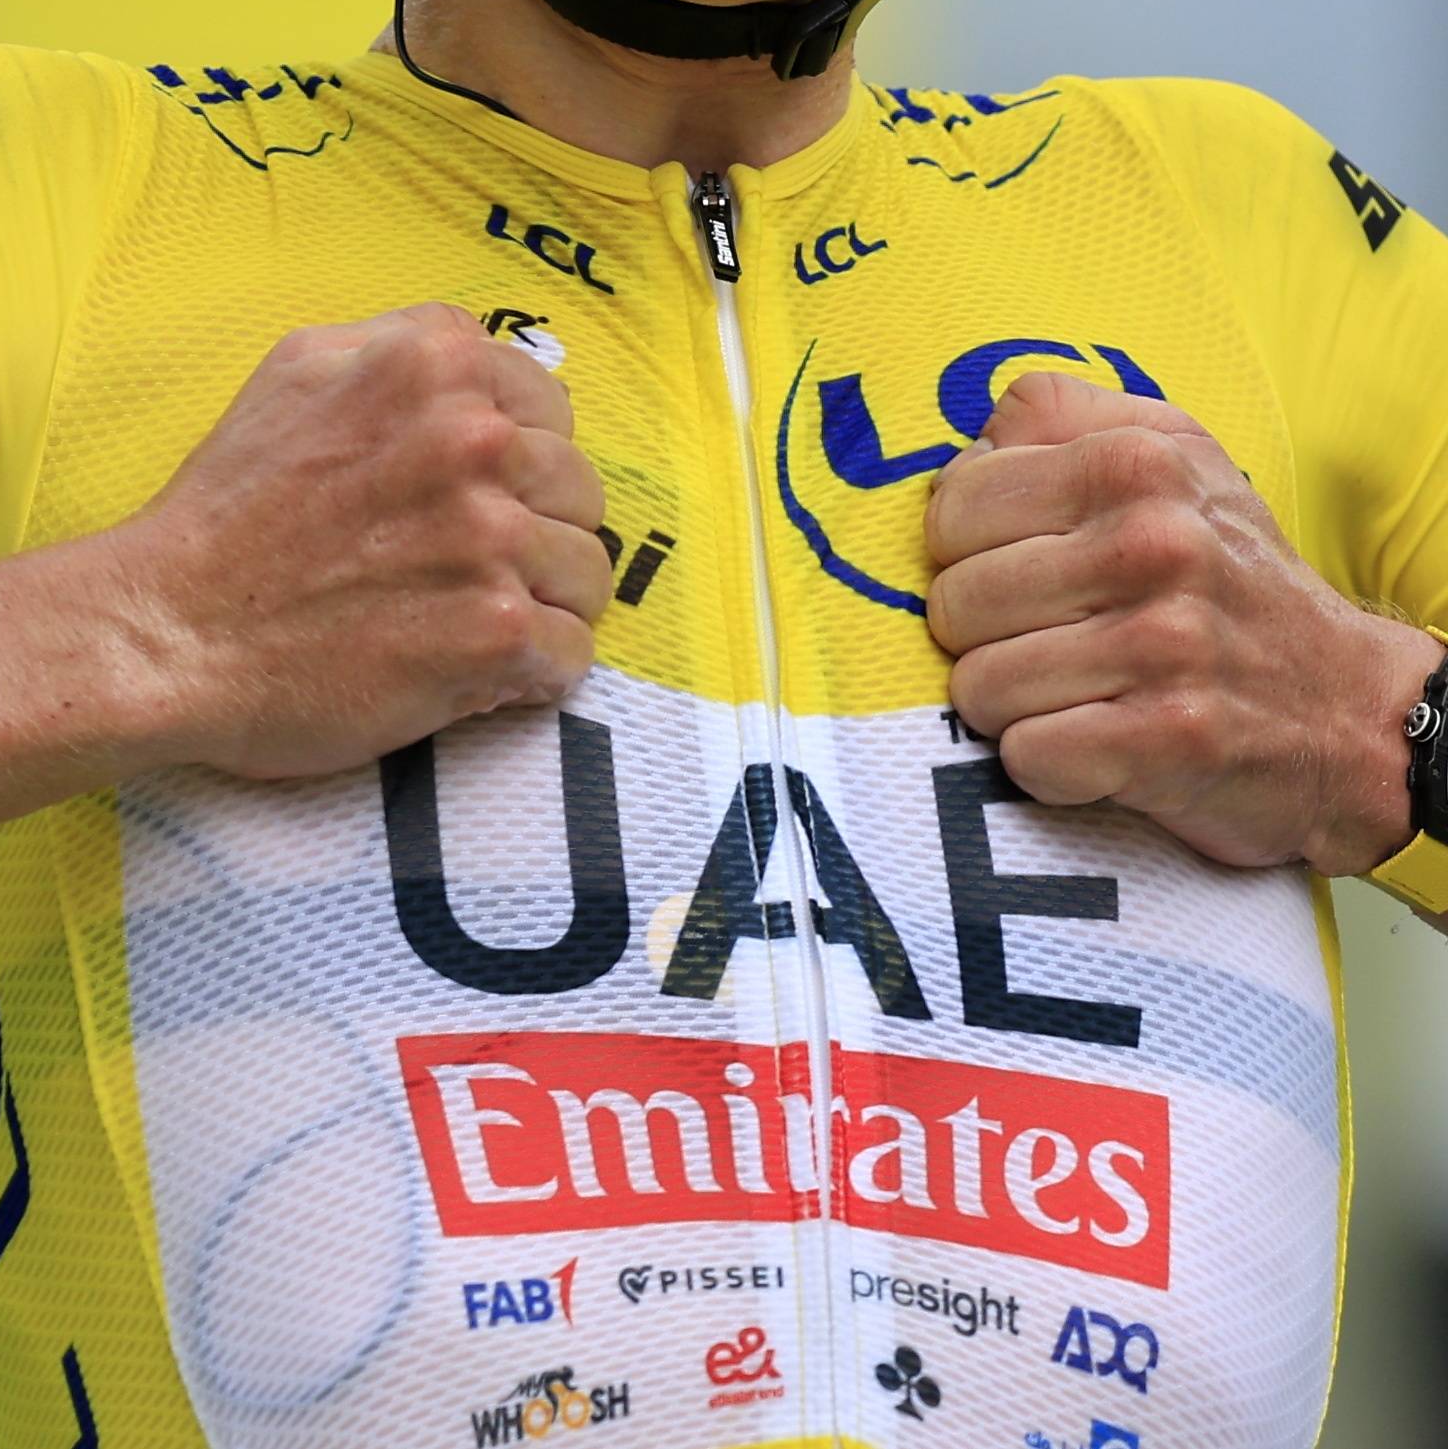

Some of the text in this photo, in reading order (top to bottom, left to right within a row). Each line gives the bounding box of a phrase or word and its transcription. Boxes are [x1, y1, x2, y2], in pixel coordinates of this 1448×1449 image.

[485, 204, 615, 295] LCL
[709, 219, 735, 267] Santini
[794, 221, 888, 286] LCL
[380, 711, 1143, 1048] UAE
[427, 1062, 1151, 1248] Emirates
[660, 1266, 785, 1293] PISSEI
[850, 1268, 1020, 1337] presight
[1051, 1305, 1160, 1394] ADQ
[471, 1382, 630, 1448] WHOOSH
